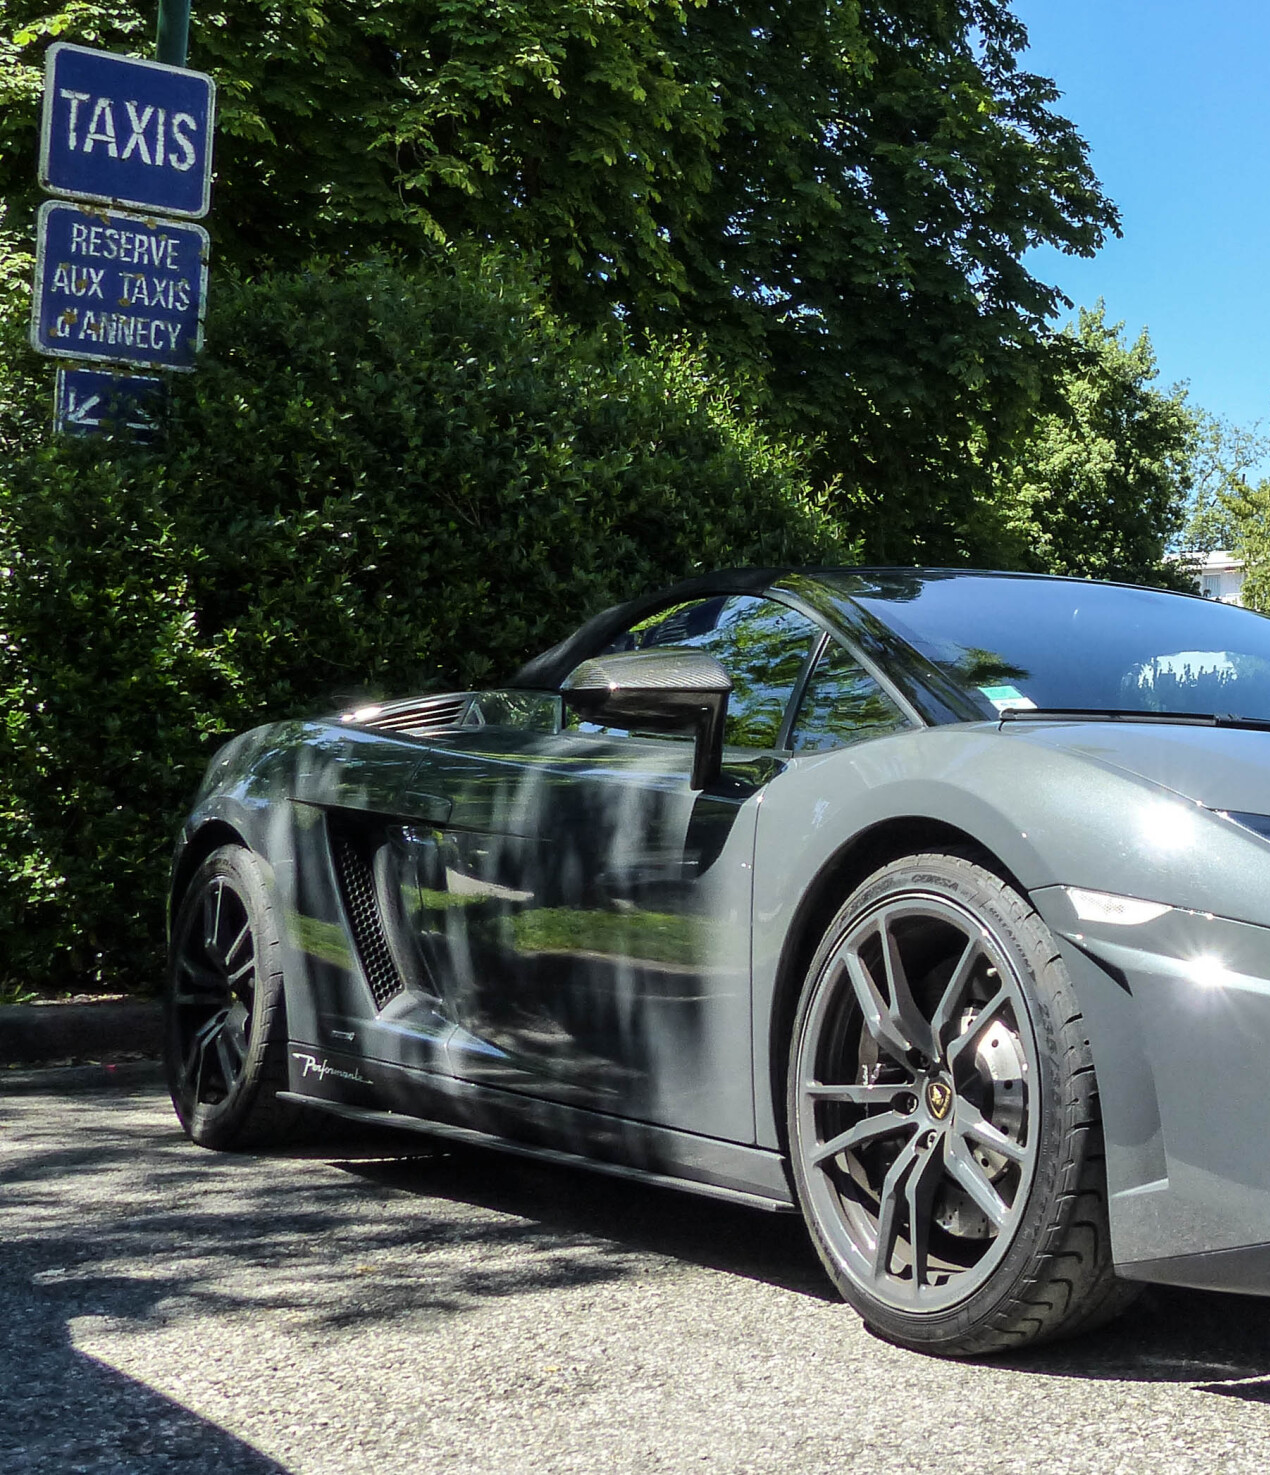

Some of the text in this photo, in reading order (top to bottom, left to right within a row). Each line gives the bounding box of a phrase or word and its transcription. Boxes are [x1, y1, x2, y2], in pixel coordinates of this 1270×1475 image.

[60, 88, 198, 172] TAXIS
[70, 222, 181, 271] RESERVE
[50, 262, 191, 312] AUX TAXIS
